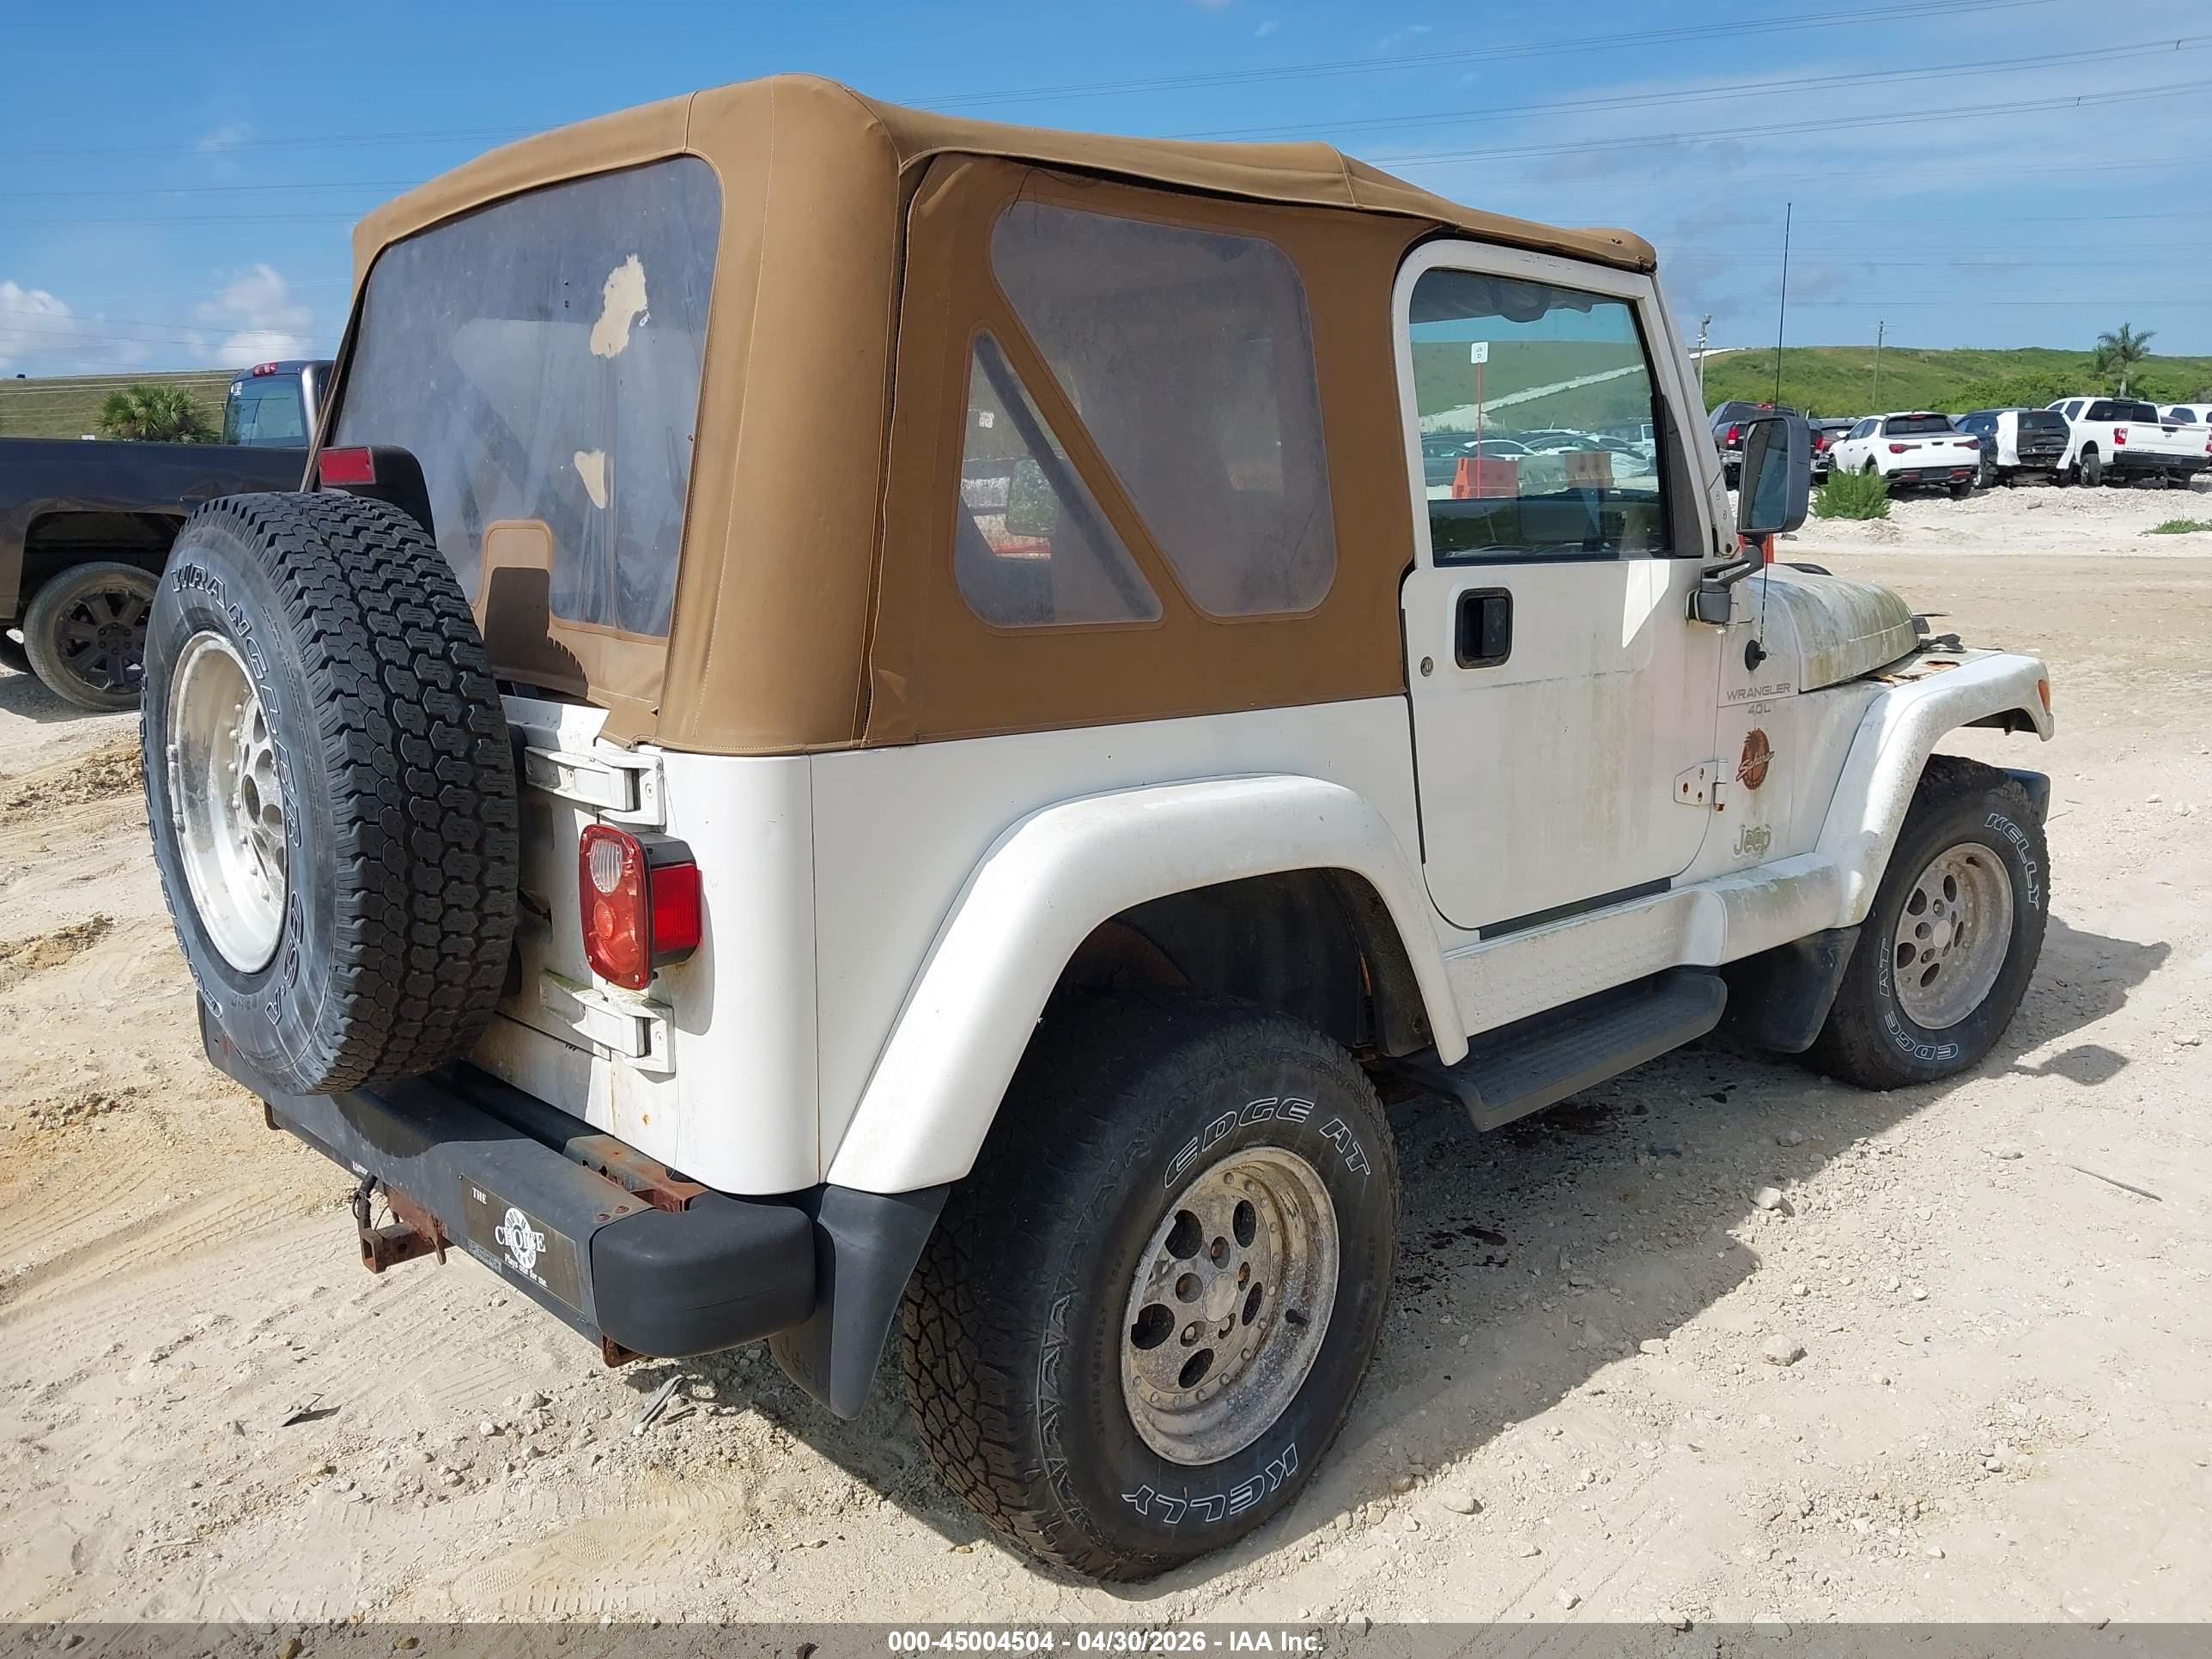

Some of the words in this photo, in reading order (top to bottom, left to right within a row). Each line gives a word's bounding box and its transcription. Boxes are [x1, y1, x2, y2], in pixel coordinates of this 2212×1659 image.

[171, 562, 301, 848] WRANGLER
[1726, 682, 1791, 702] WRANGLER
[1984, 811, 2040, 911] KELLY
[1879, 937, 1890, 998] AT
[1884, 1010, 1959, 1060] EDGE
[1164, 1097, 1316, 1189] EDGE
[1319, 1117, 1371, 1176] AT
[471, 1187, 488, 1205] THE
[495, 1224, 546, 1253] CHOICE
[1121, 1443, 1298, 1524] KELLY
